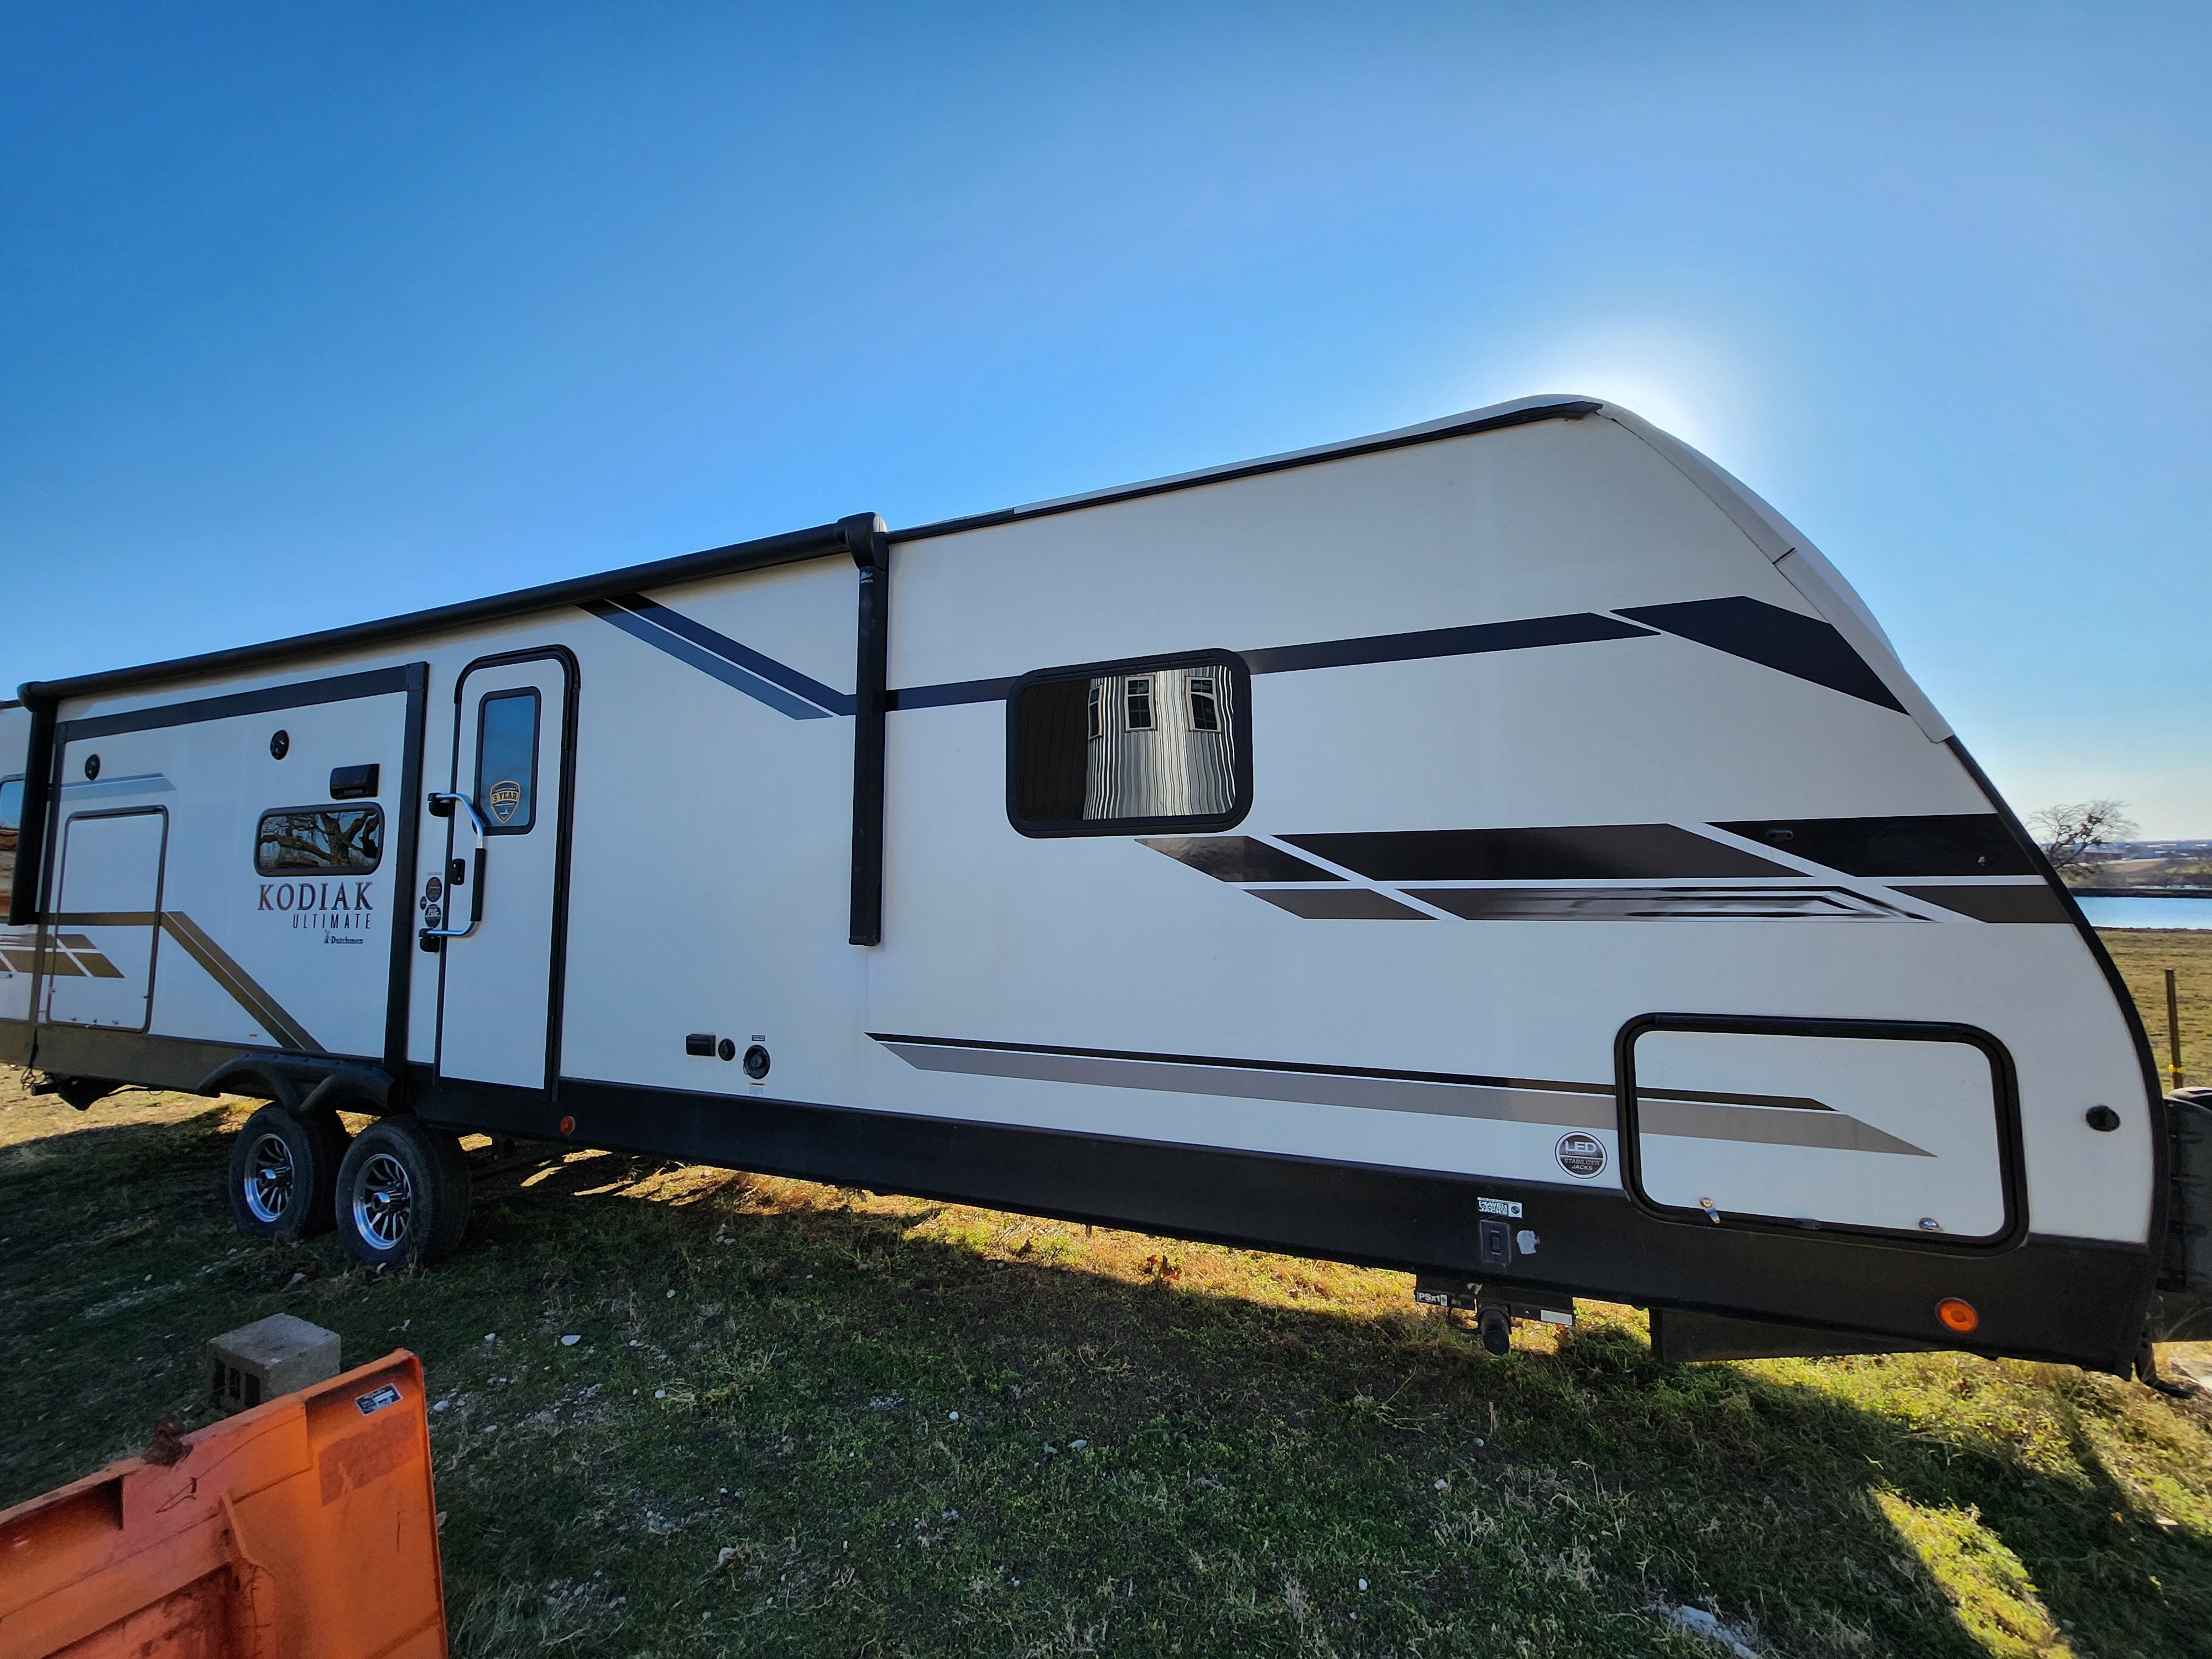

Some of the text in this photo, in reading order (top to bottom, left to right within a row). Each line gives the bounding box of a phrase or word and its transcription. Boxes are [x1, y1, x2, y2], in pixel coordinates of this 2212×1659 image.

[499, 791, 517, 800] YEAR
[258, 881, 373, 911] KODIAK
[293, 914, 371, 929] ULTIMATE
[331, 936, 363, 944] Dutchmen
[1565, 1140, 1597, 1152] LED
